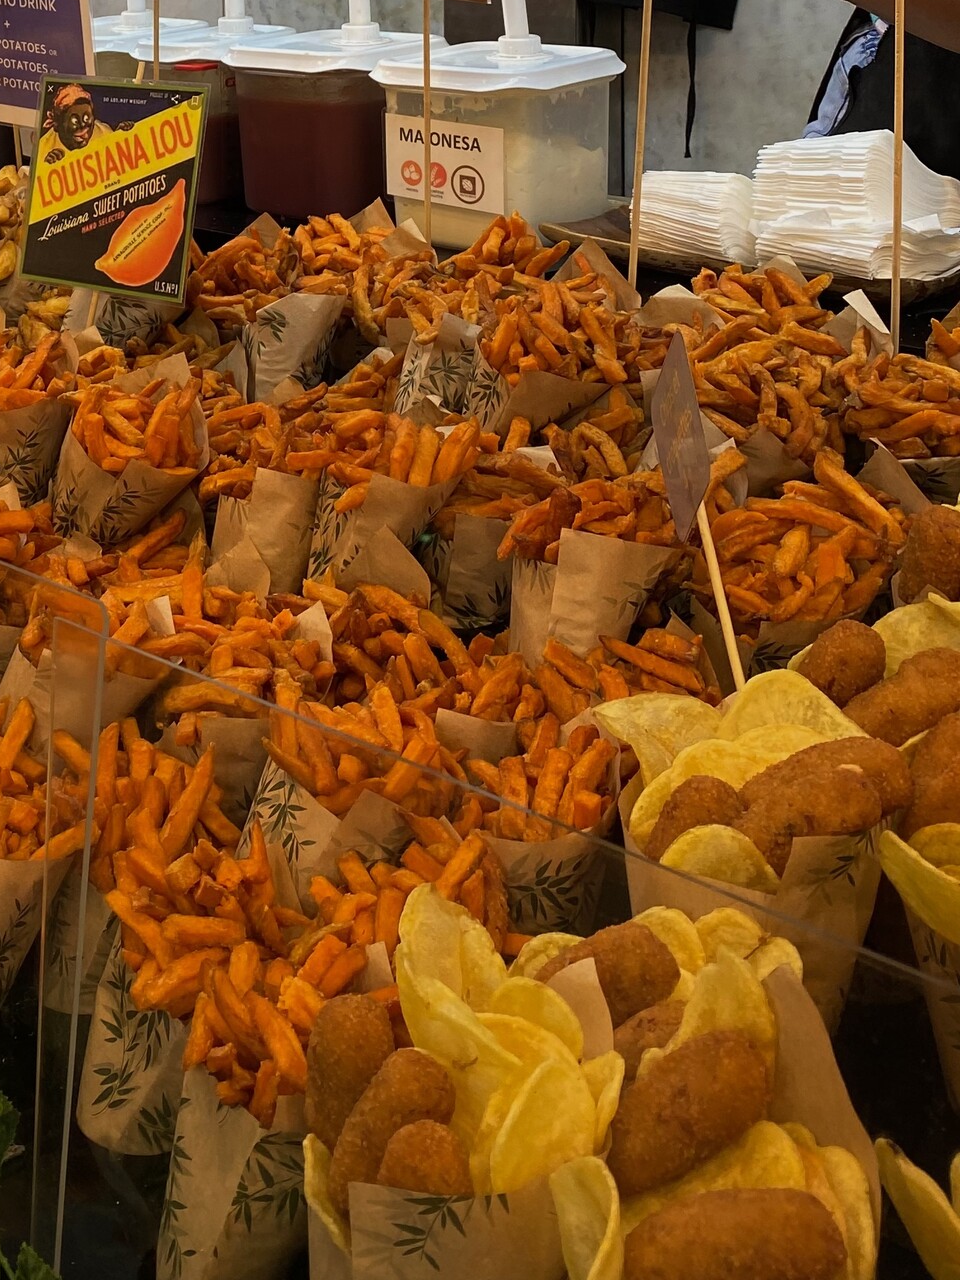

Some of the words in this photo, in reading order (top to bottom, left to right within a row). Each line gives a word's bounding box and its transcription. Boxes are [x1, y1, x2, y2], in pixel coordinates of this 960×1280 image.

[3, 78, 40, 92] POTATO
[399, 127, 481, 152] MAONESA
[37, 133, 151, 208] LOUISIANA
[150, 111, 194, 161] LOU
[38, 214, 90, 241] Louisiana
[93, 191, 121, 218] SWEET
[123, 174, 167, 206] POTATOES
[81, 222, 97, 234] HAND
[98, 210, 126, 228] SELECTED
